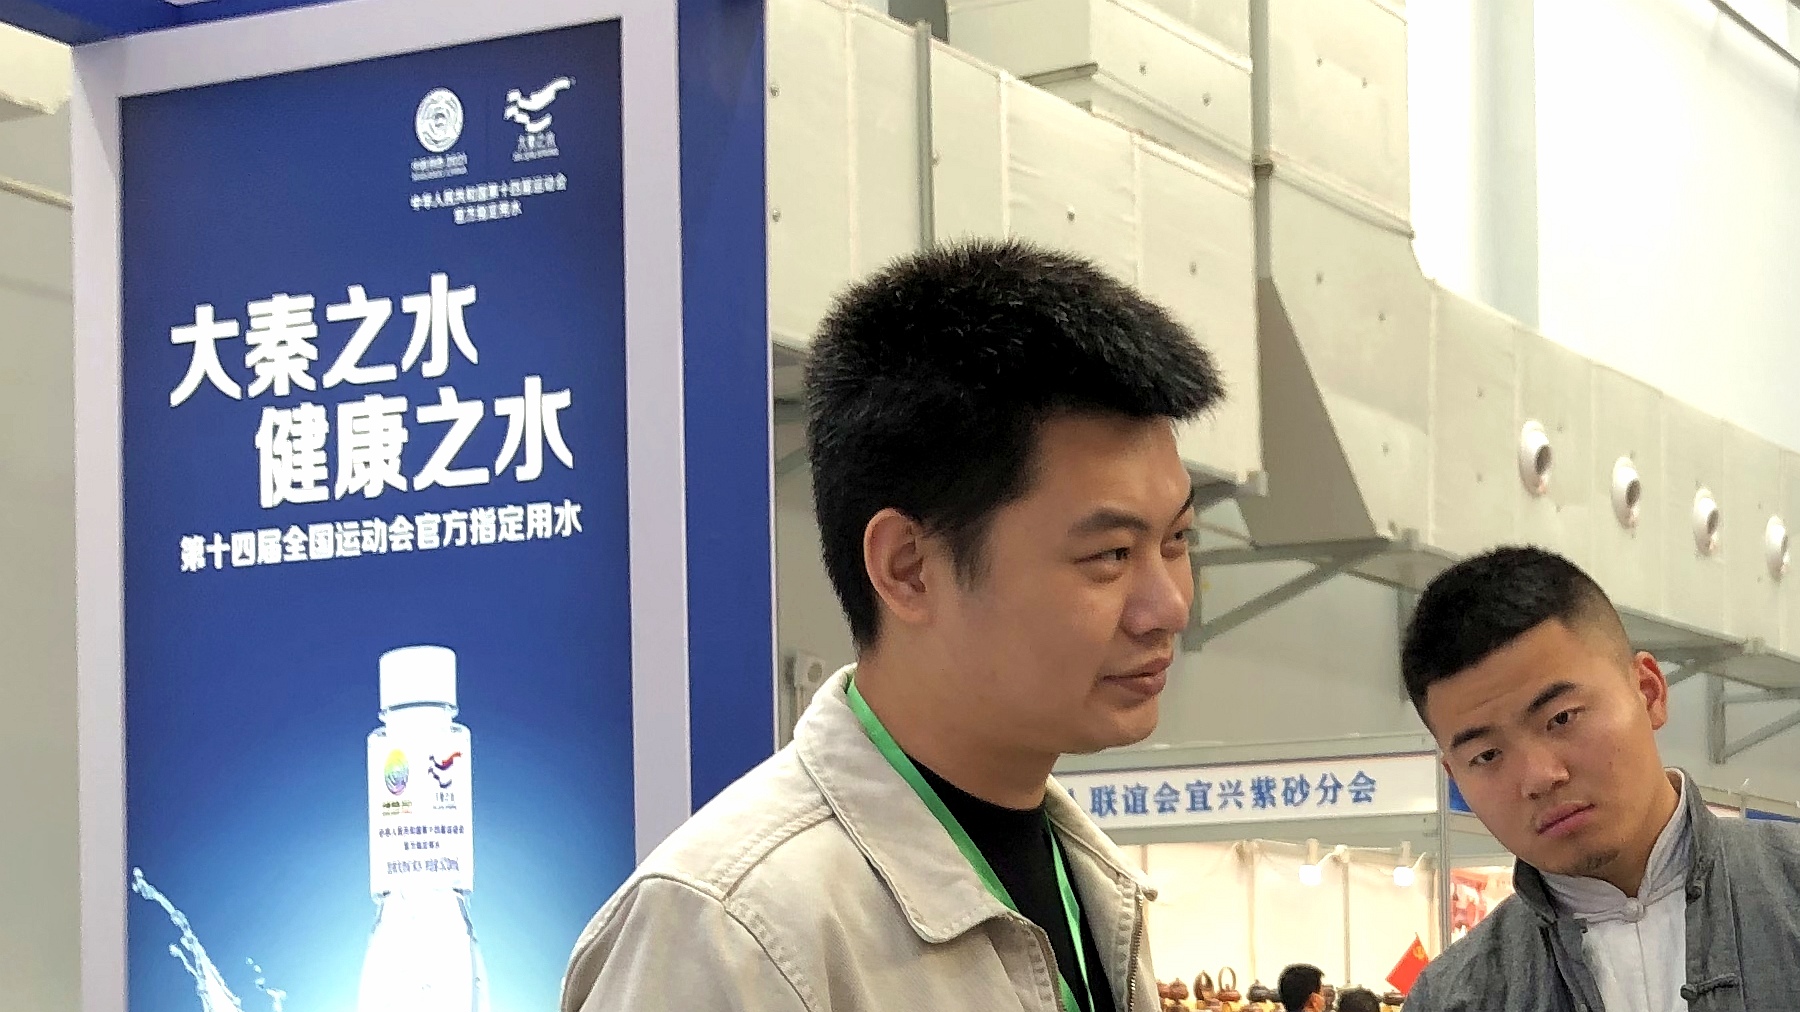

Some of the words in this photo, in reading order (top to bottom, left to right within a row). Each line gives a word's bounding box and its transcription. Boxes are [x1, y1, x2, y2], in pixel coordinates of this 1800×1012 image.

[169, 271, 480, 408] 大秦之水
[254, 374, 575, 509] 健康之水
[180, 498, 583, 573] 第十四届全国运动会官方指定用水
[1067, 769, 1377, 819] 联谊会宜兴紫砂分会
